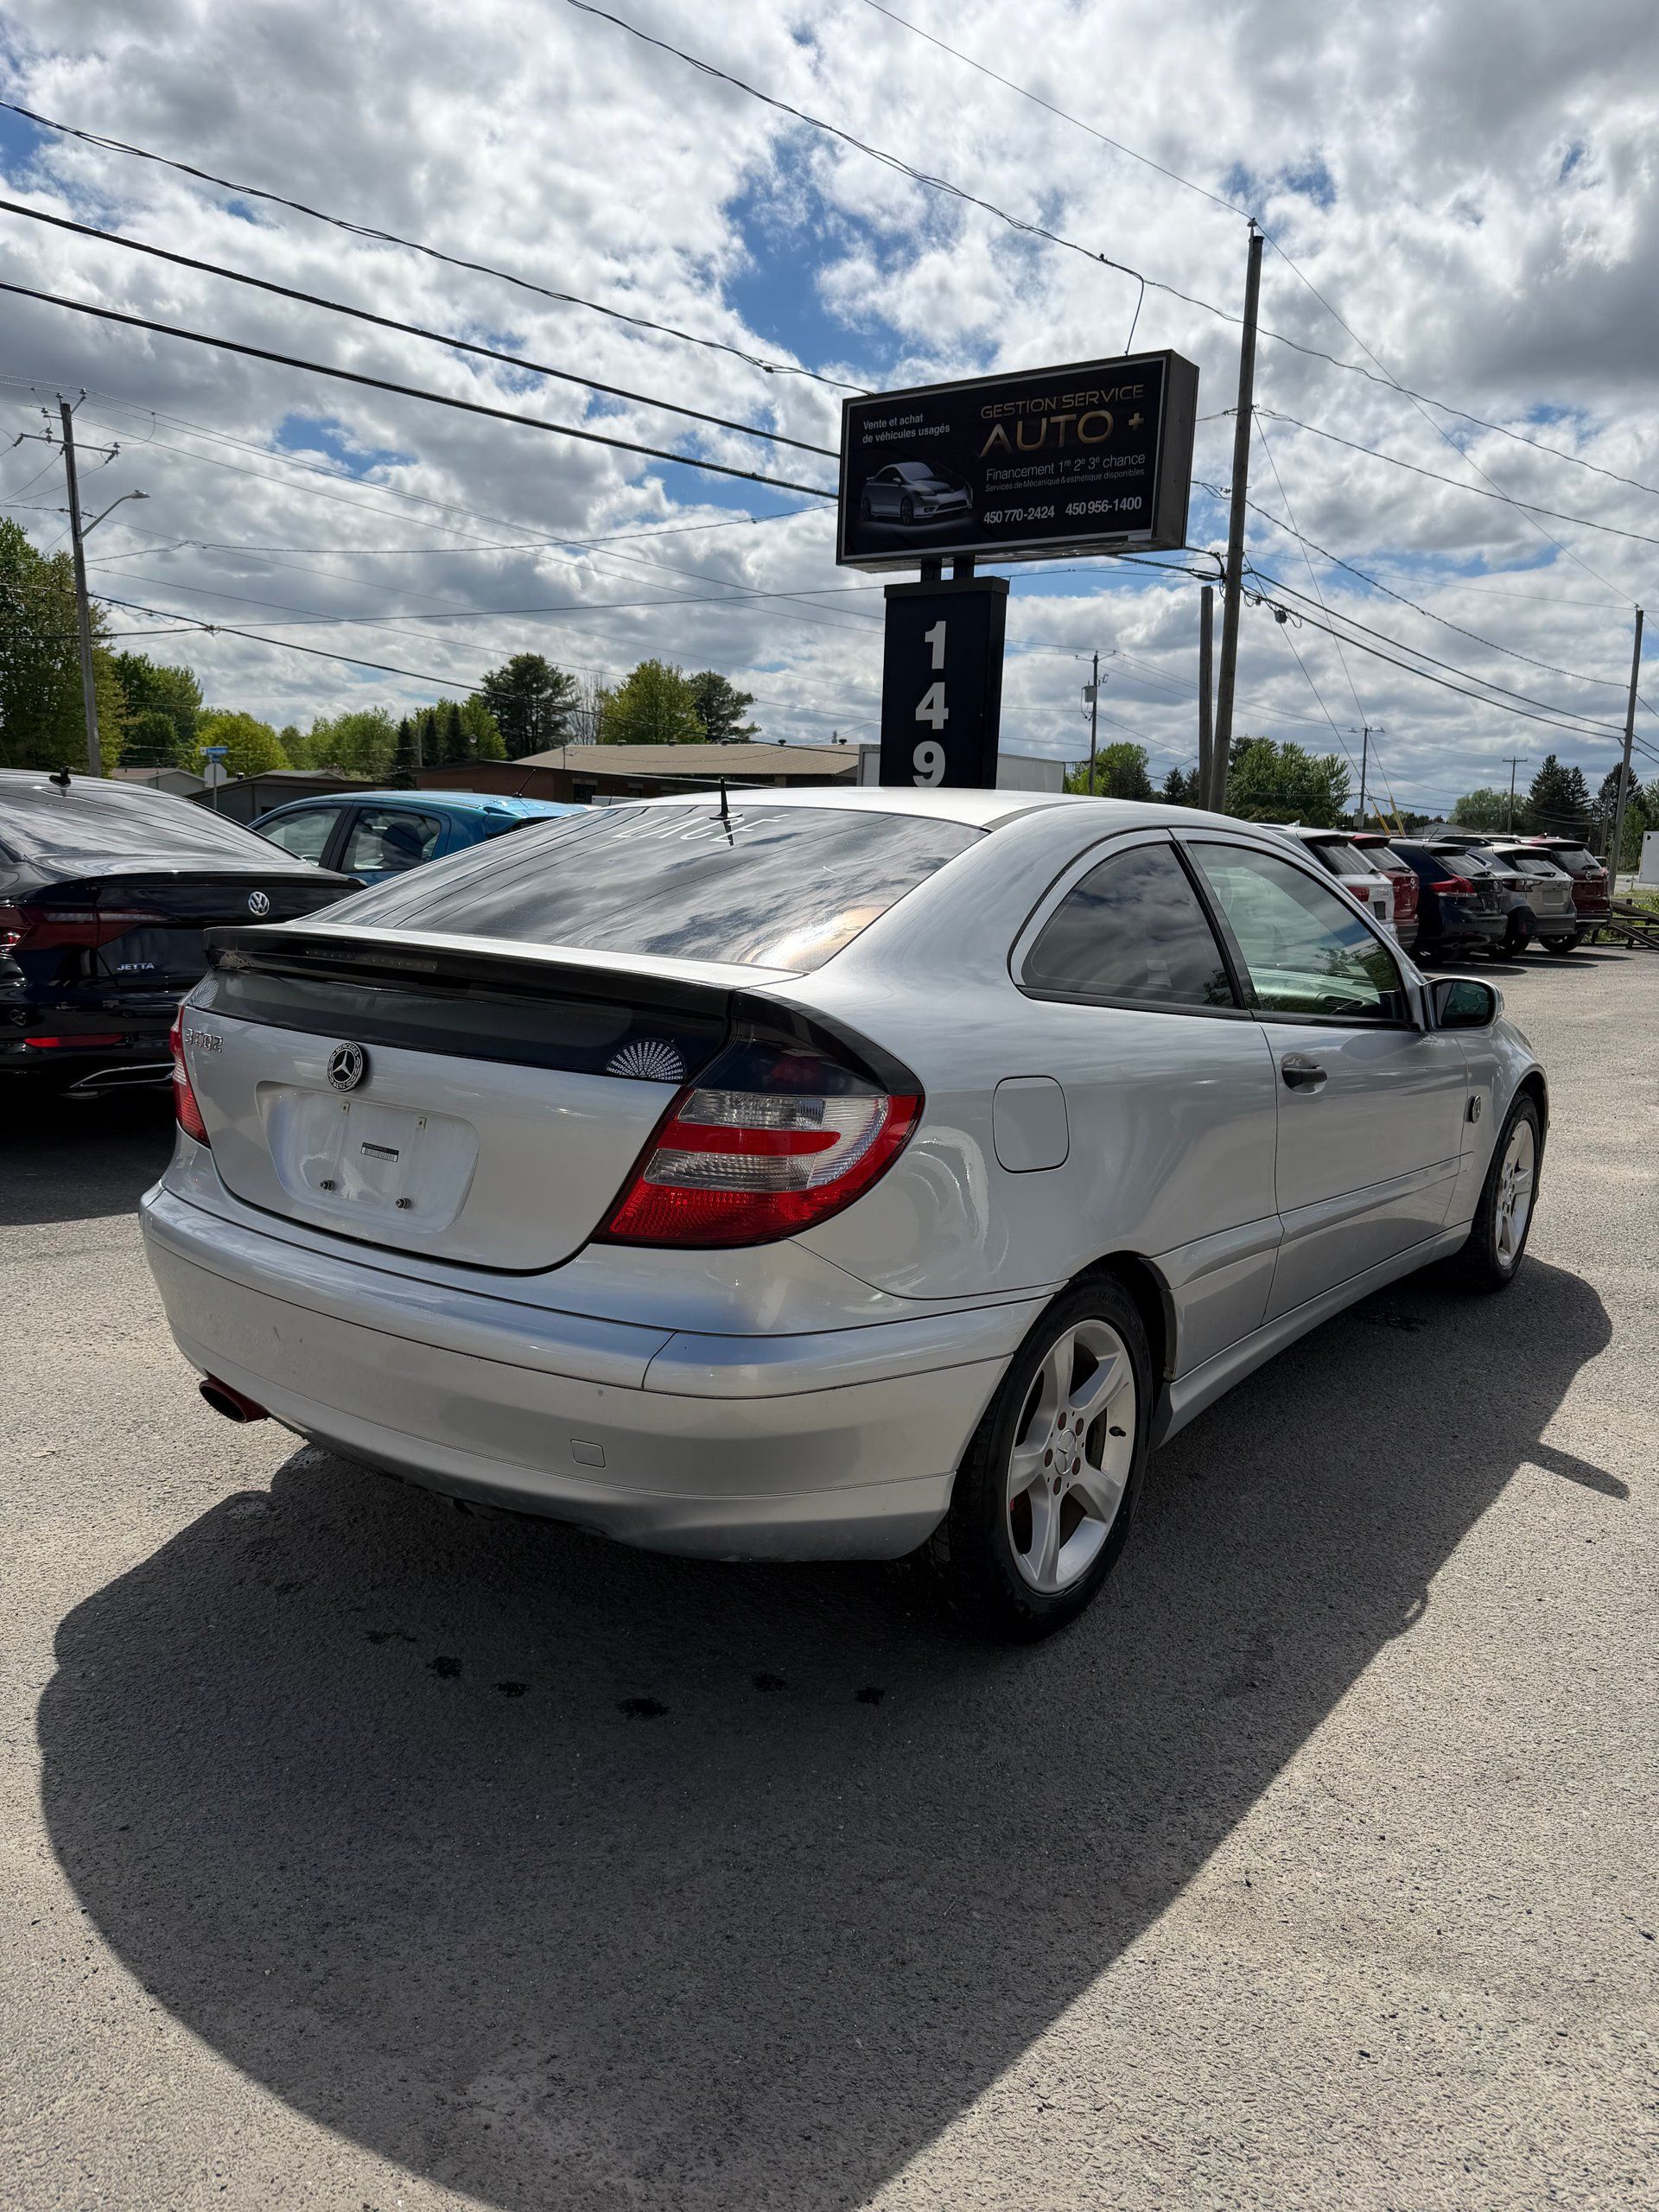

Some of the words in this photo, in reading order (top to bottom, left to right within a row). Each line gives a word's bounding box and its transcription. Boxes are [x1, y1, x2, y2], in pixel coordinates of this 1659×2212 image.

[981, 397, 1057, 419] GESTION
[1061, 384, 1145, 409] SERVICE
[862, 434, 874, 443] de
[875, 429, 916, 442] véhicules
[918, 423, 950, 436] usagés
[863, 418, 887, 430] Vente
[888, 416, 898, 427] et
[899, 413, 924, 425] achat
[978, 410, 1115, 458] AUTO
[986, 461, 1054, 481] Financement
[1103, 454, 1146, 469] chance
[983, 510, 1003, 524] 450
[1004, 505, 1055, 523] 770-2424
[1065, 502, 1087, 516] 450
[1087, 496, 1142, 513] 956-1400
